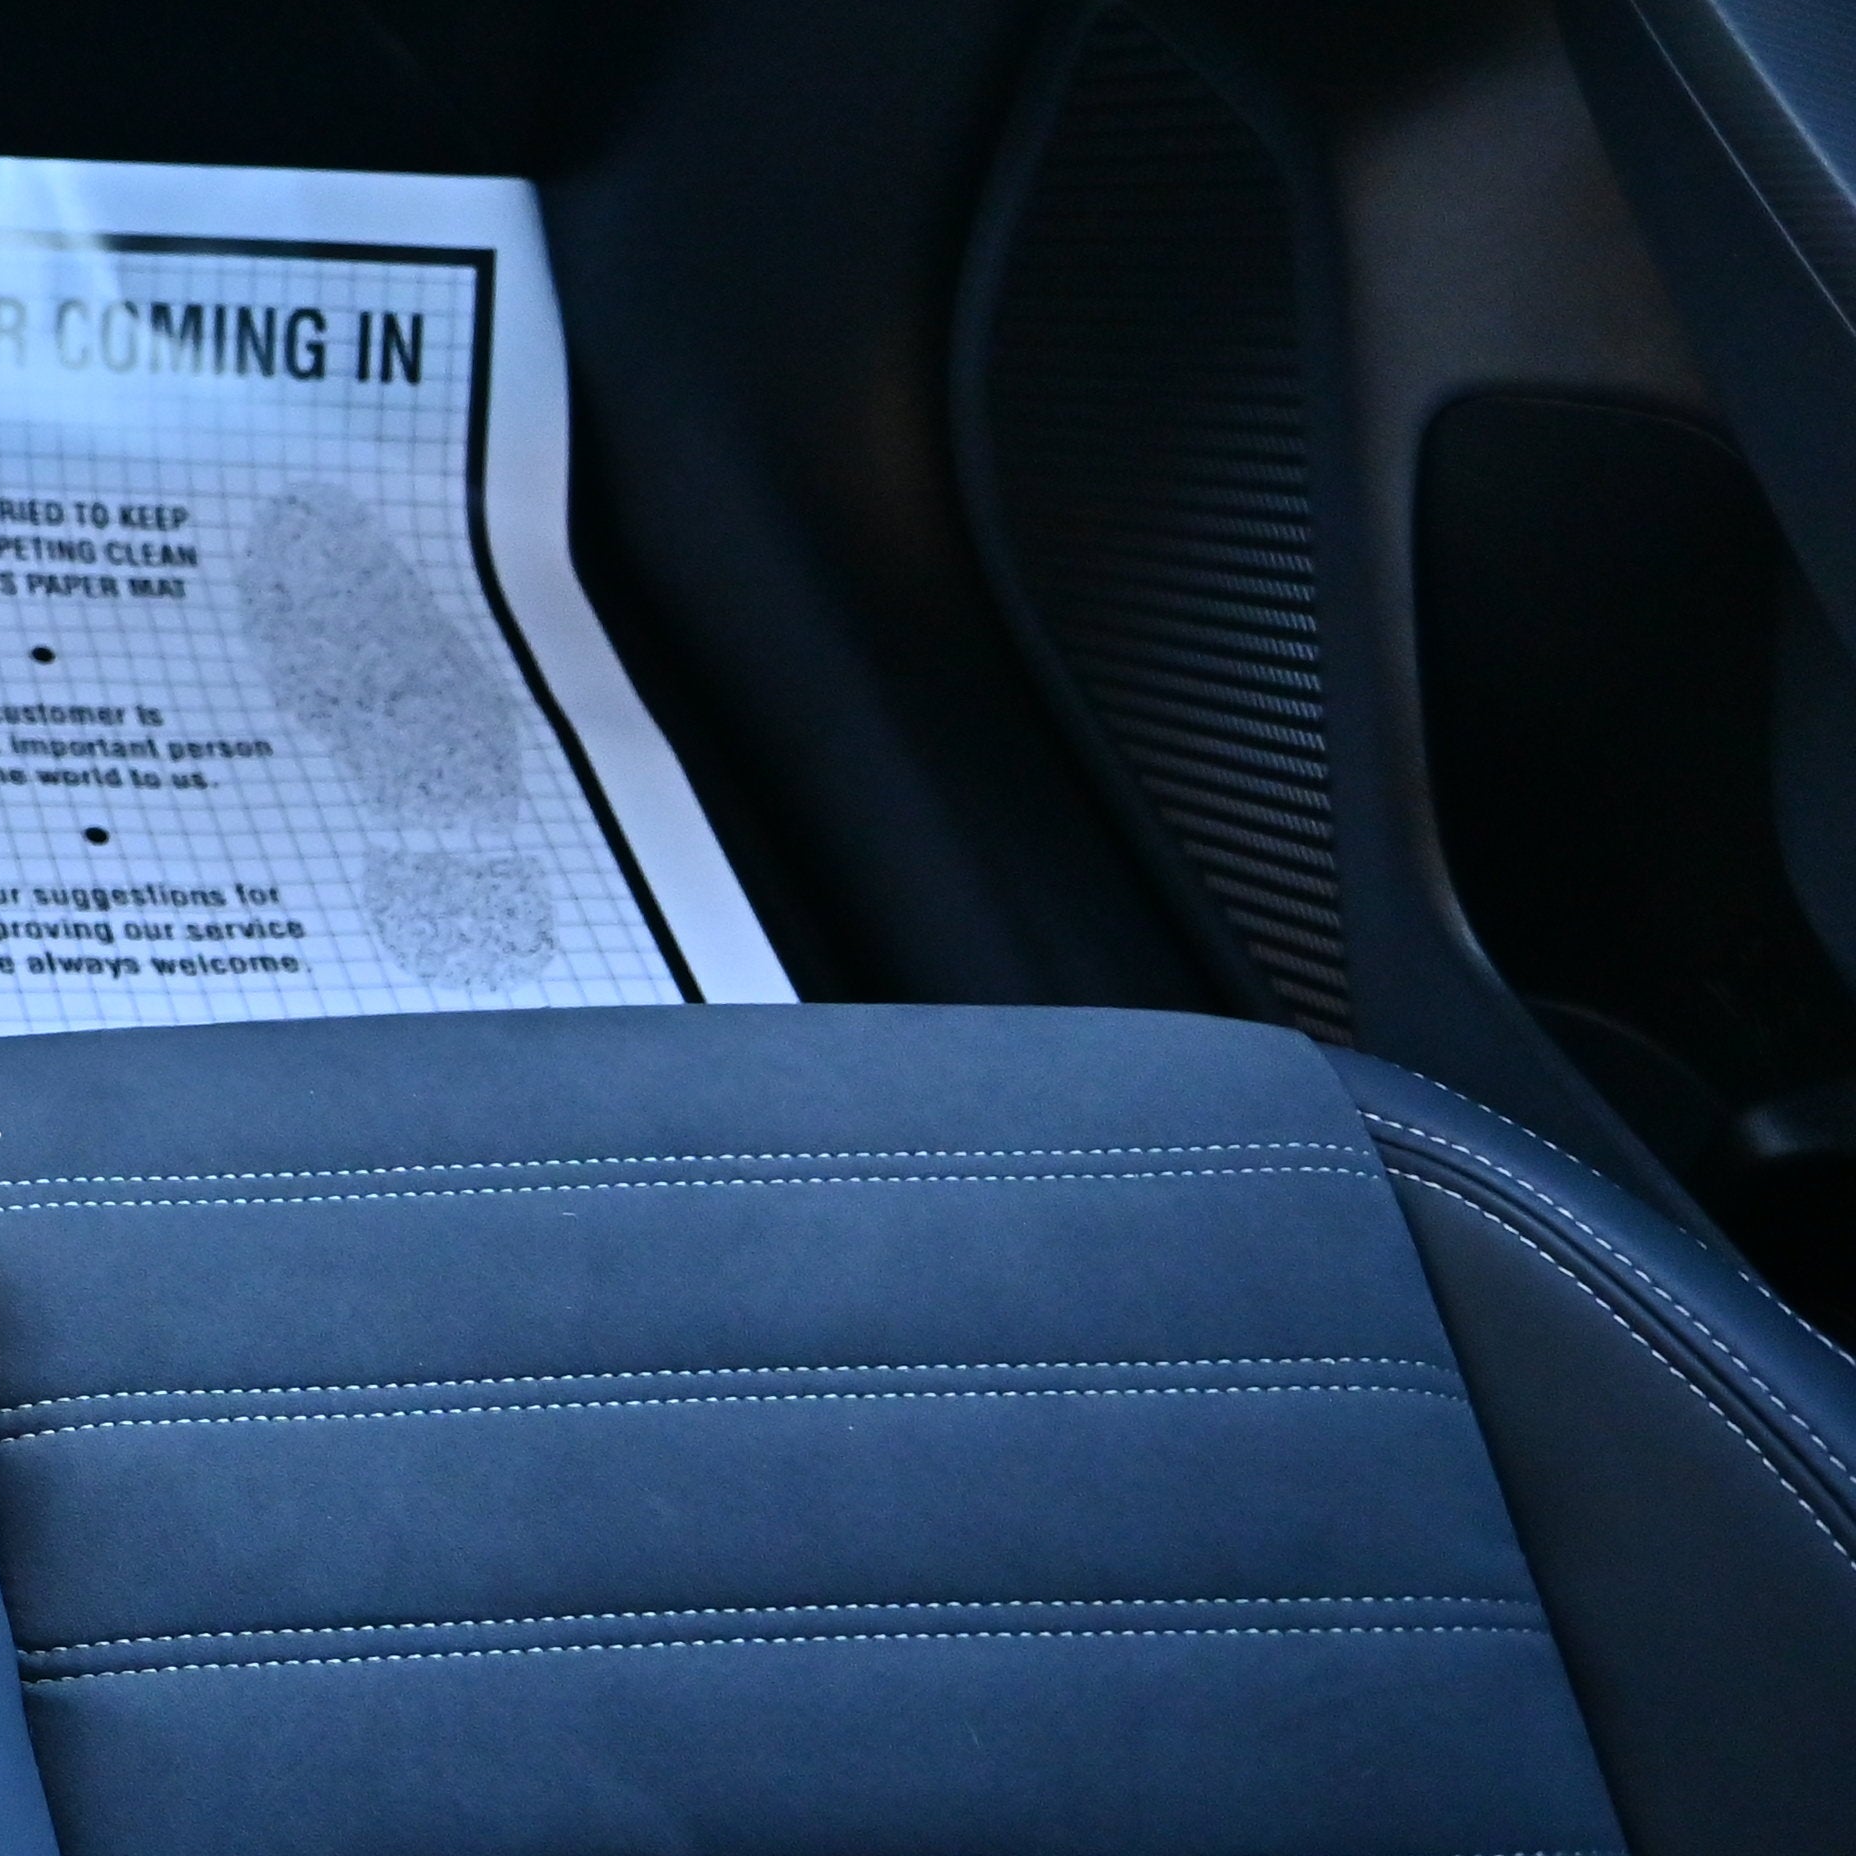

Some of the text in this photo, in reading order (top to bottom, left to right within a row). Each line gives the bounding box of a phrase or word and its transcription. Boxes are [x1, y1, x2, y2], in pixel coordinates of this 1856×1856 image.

[55, 294, 329, 382] COMING
[356, 310, 425, 387] IN
[74, 502, 110, 529] TO
[119, 504, 190, 532] KEEP
[103, 541, 198, 568] CLEAN
[27, 573, 118, 599] PAPER
[127, 577, 186, 600] MAT
[136, 704, 165, 727] is
[11, 733, 159, 761] important
[169, 738, 274, 762] person
[36, 764, 122, 788] world
[130, 766, 162, 789] to
[170, 770, 219, 789] us.
[32, 883, 227, 911] suggestions
[234, 882, 281, 904] for
[125, 920, 174, 942] our
[185, 917, 306, 940] service
[26, 952, 141, 979] always
[150, 953, 311, 976] welcome.
